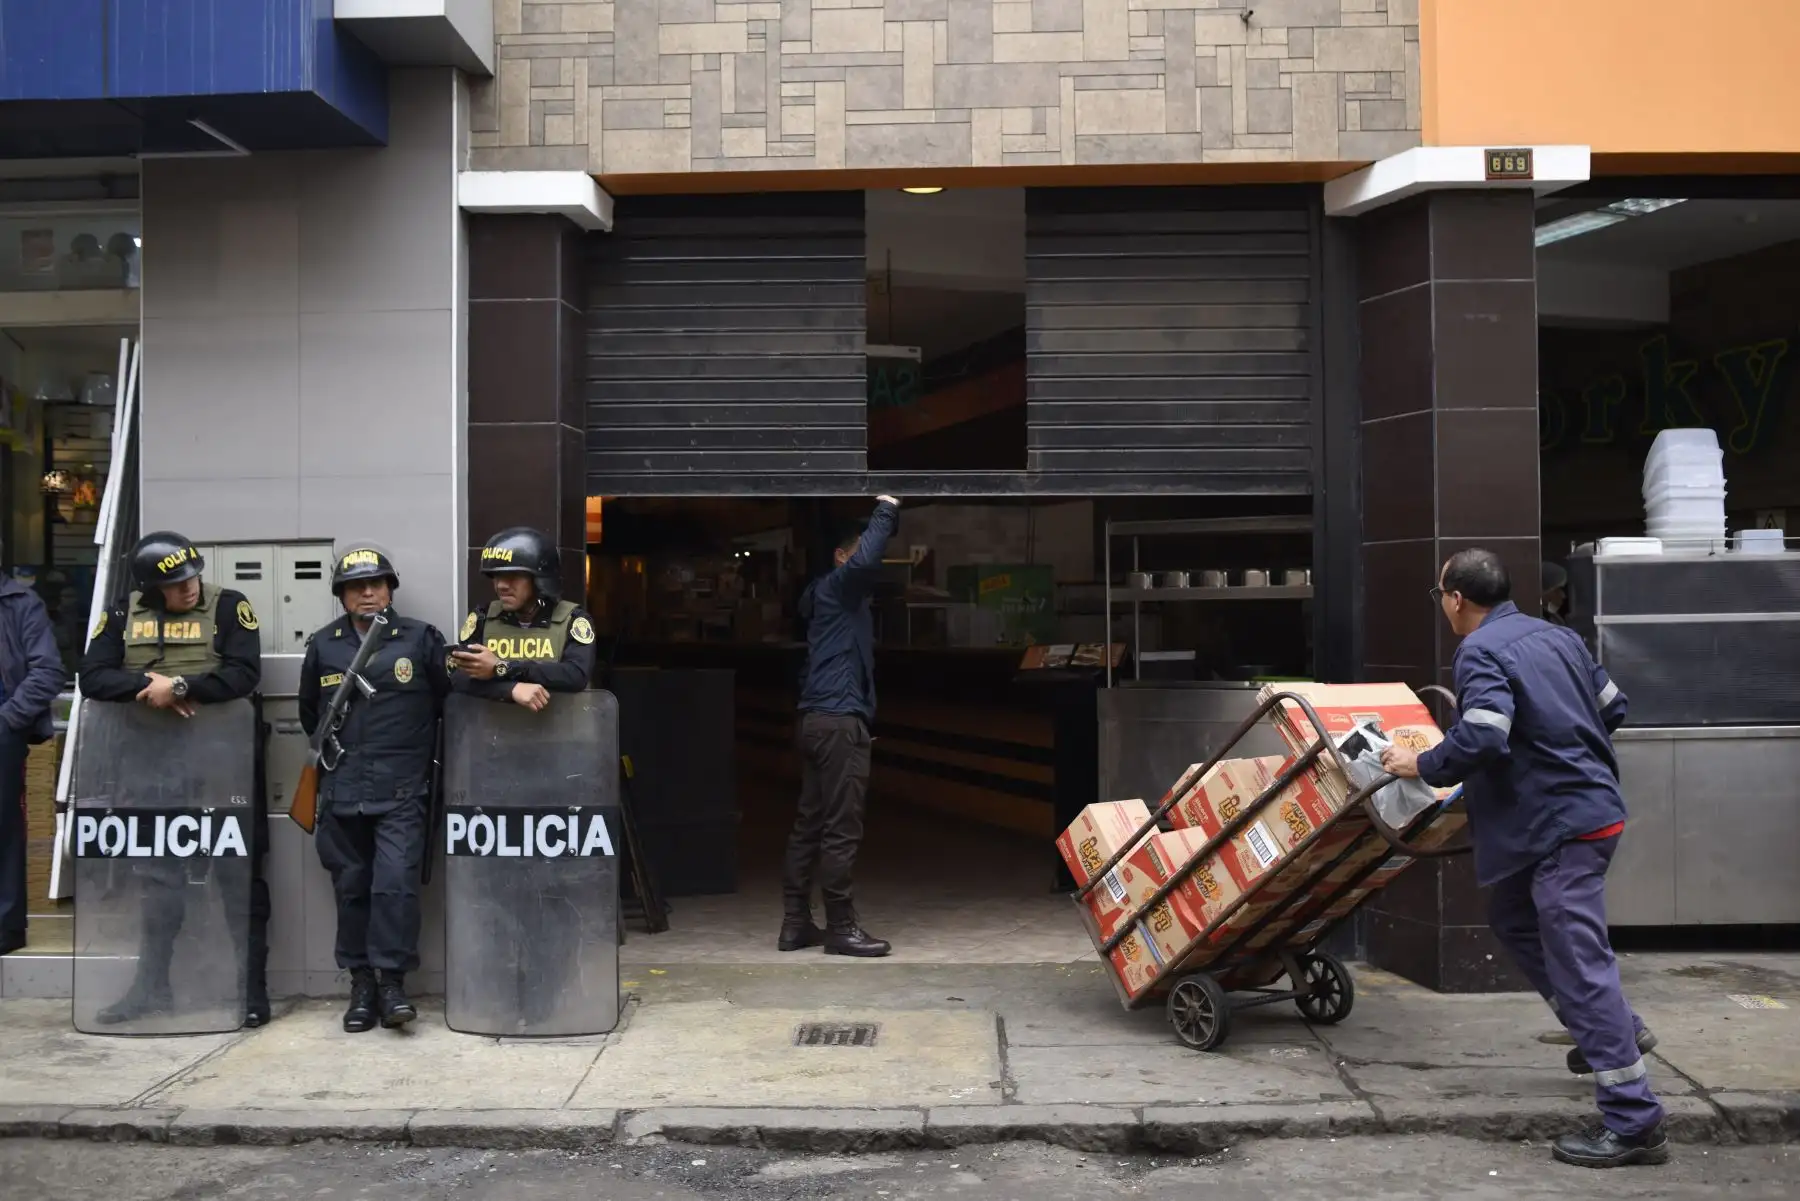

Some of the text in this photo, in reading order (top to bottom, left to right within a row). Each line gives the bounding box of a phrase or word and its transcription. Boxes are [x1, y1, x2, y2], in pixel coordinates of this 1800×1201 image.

[157, 547, 198, 574] POLICA
[343, 548, 379, 568] POLICIA
[487, 638, 555, 659] POLICIA
[76, 814, 248, 858] POLICIA
[446, 813, 615, 858] POLICIA
